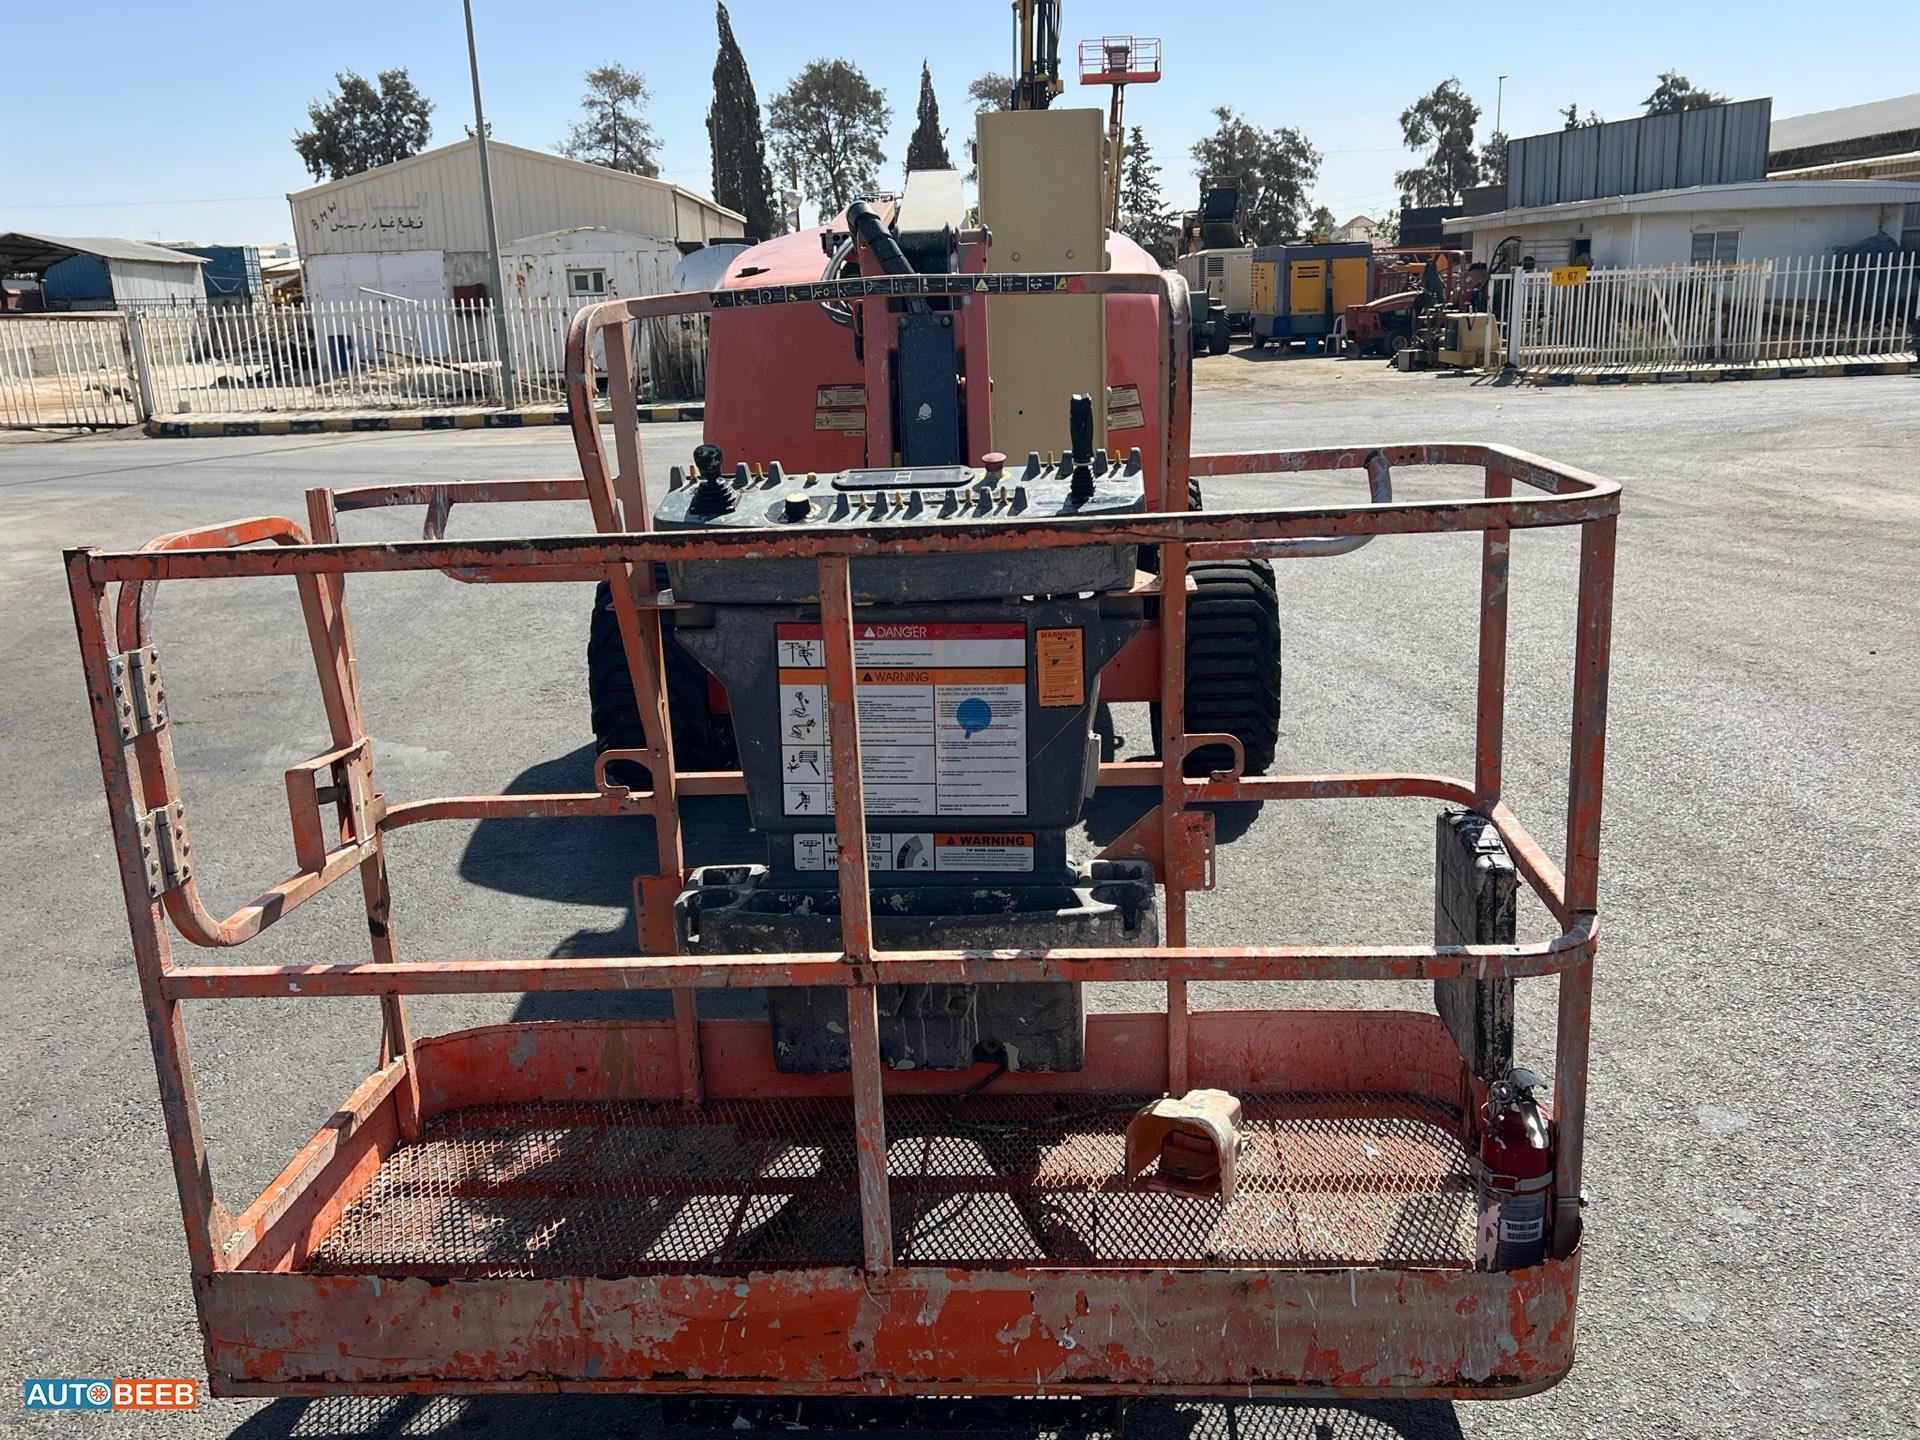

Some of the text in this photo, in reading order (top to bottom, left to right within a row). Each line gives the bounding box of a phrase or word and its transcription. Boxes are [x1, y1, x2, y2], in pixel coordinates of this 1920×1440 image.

[397, 217, 423, 233] قطع
[1567, 271, 1578, 281] 67
[877, 626, 927, 638] DANGER
[1040, 631, 1077, 639] WARNING
[875, 671, 929, 682] WARNING
[960, 836, 1025, 846] WARNING
